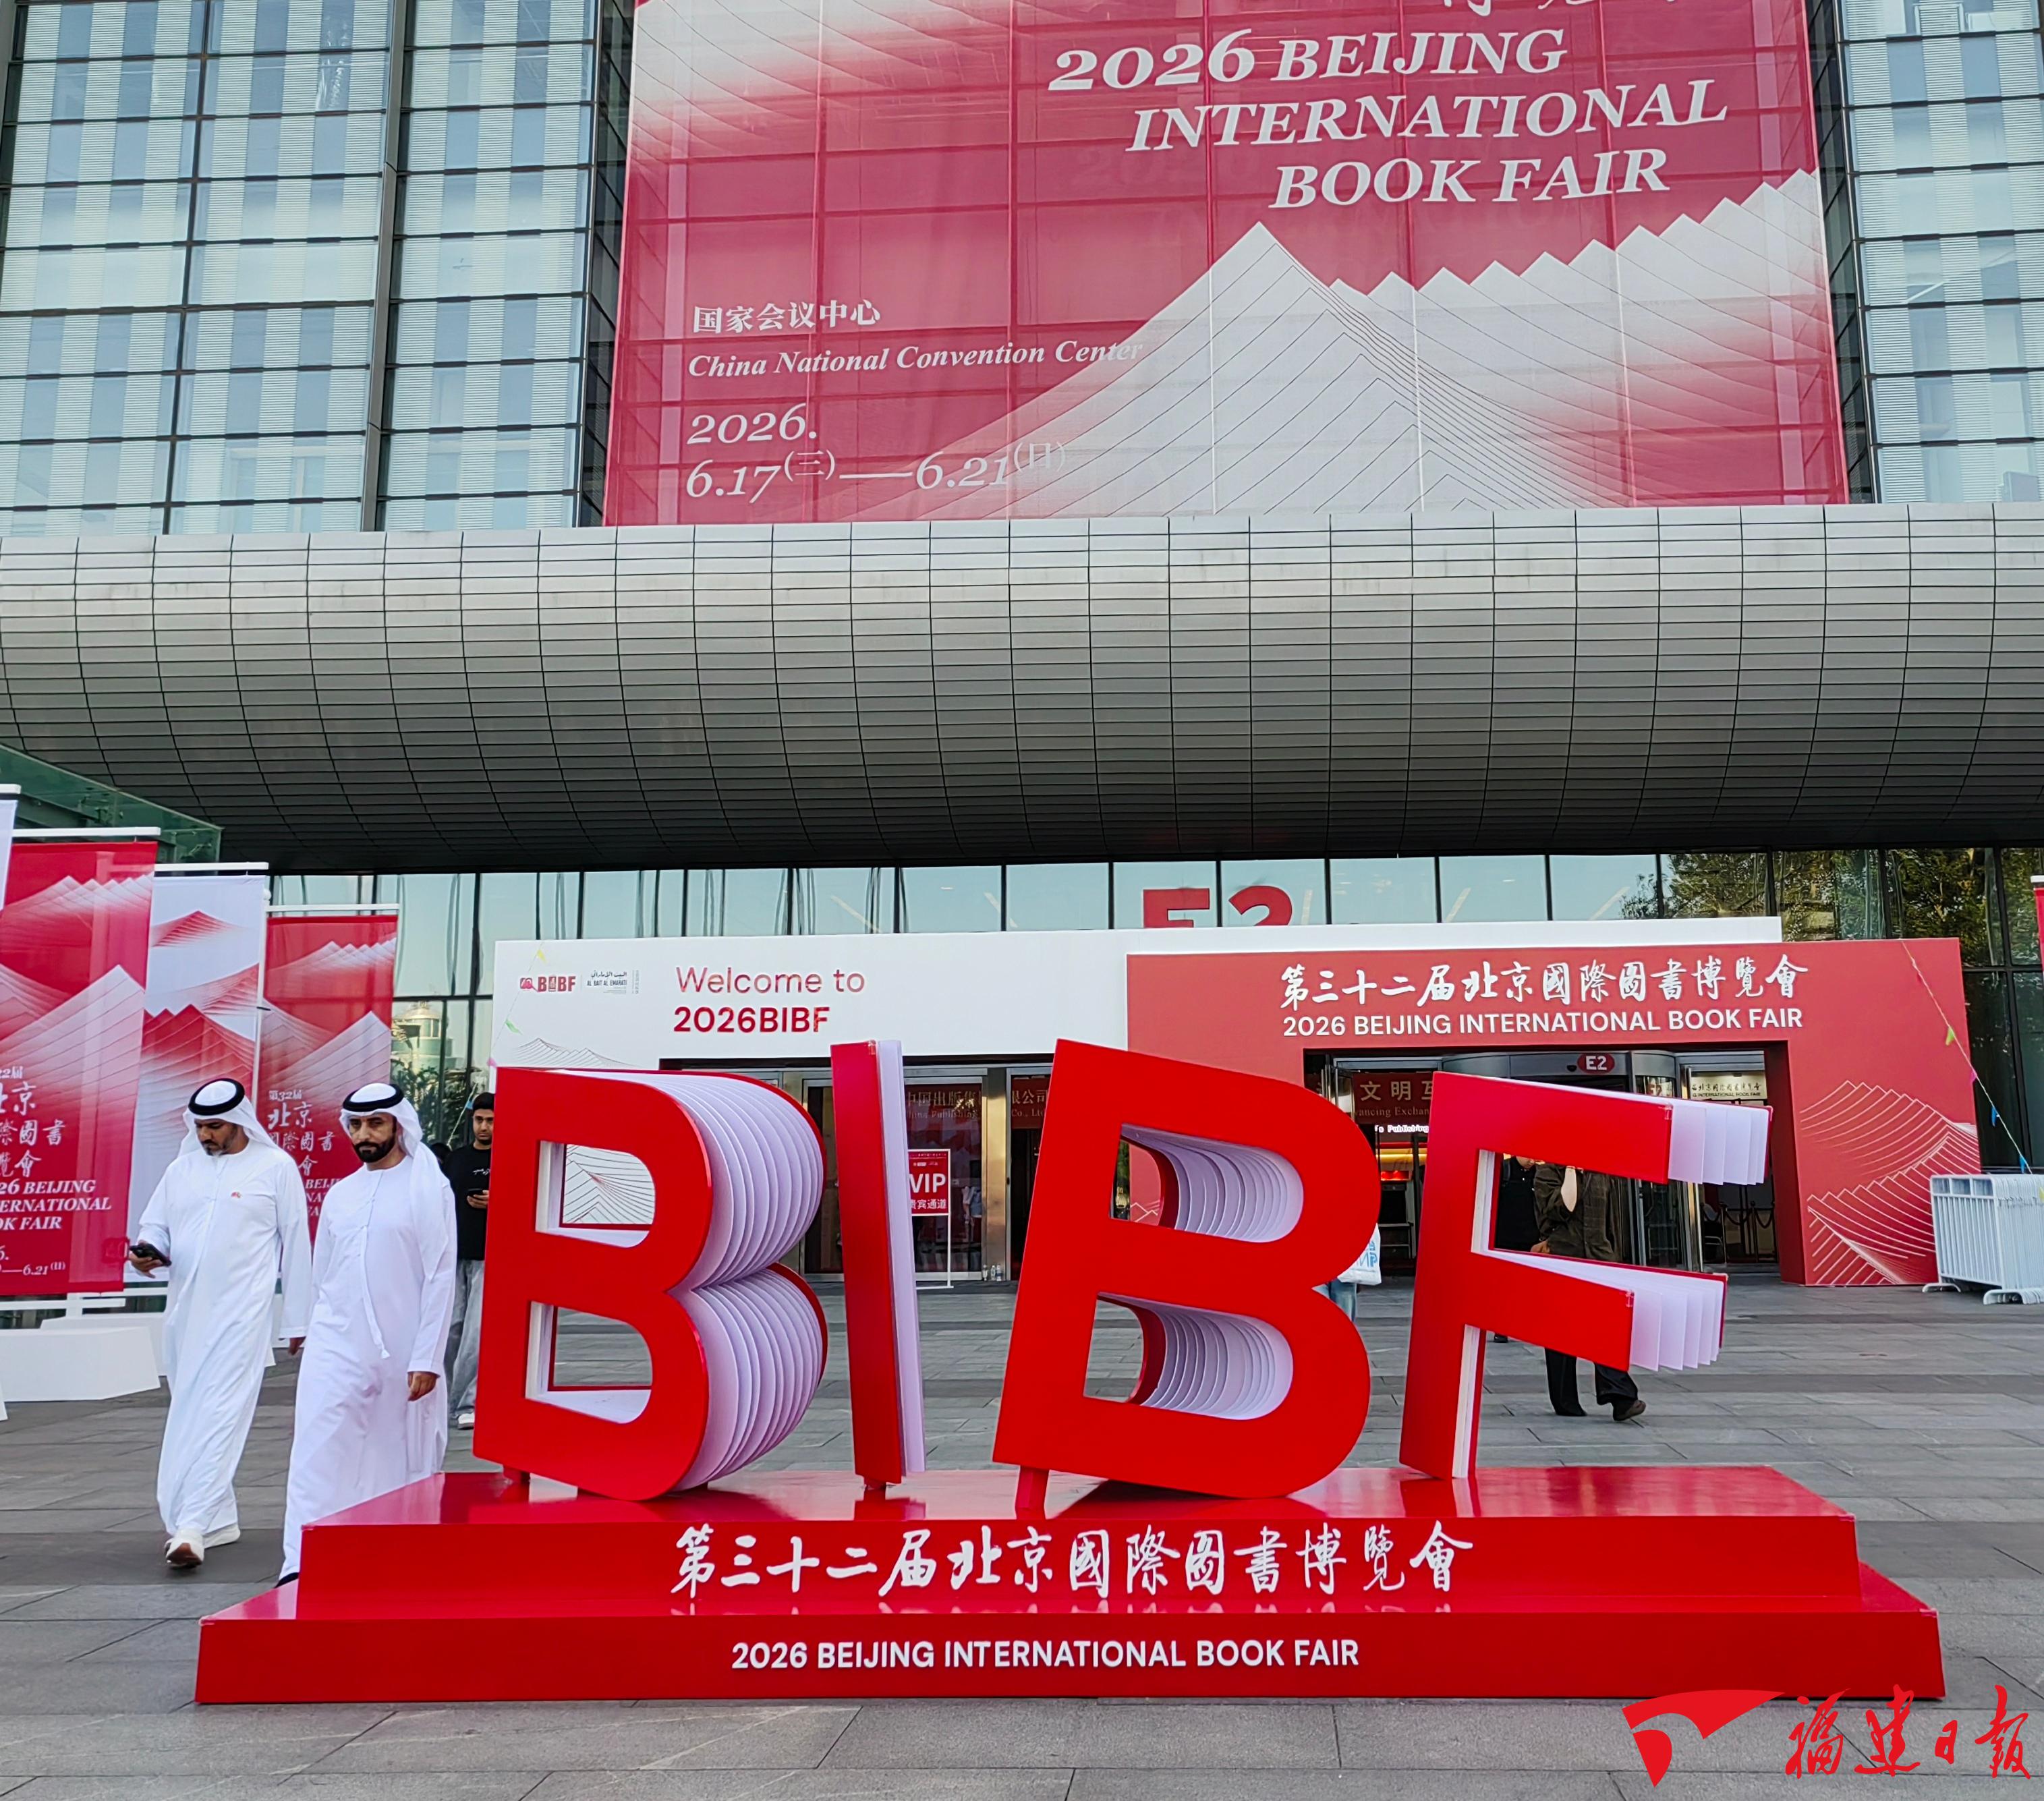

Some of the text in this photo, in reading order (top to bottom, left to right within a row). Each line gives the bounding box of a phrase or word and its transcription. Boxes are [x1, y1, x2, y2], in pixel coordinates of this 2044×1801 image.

[1048, 28, 1567, 90] 2026 BEIJING
[1126, 79, 1728, 151] INTERNATIONAL
[1269, 148, 1670, 208] BOOK FAIR
[693, 299, 880, 333] 国家会议中心
[688, 340, 1143, 378] China National Convention Center
[686, 403, 818, 445] 2026.
[676, 967, 865, 994] Welcome to
[674, 1006, 830, 1033] 2026BIBF
[1283, 1007, 1803, 1037] 2026 BEIJING INTERNATIONAL BOOK FAIR
[1586, 1056, 1608, 1070] E2
[267, 1101, 313, 1129] 北京
[23, 1180, 96, 1195] BEIJING
[909, 1173, 946, 1193] VIP
[19, 1216, 62, 1230] FAIR
[474, 1039, 1770, 1501] BIBF
[731, 1638, 1359, 1670] 2026 BEIJING INTERNATIONAL BOOK FAIR
